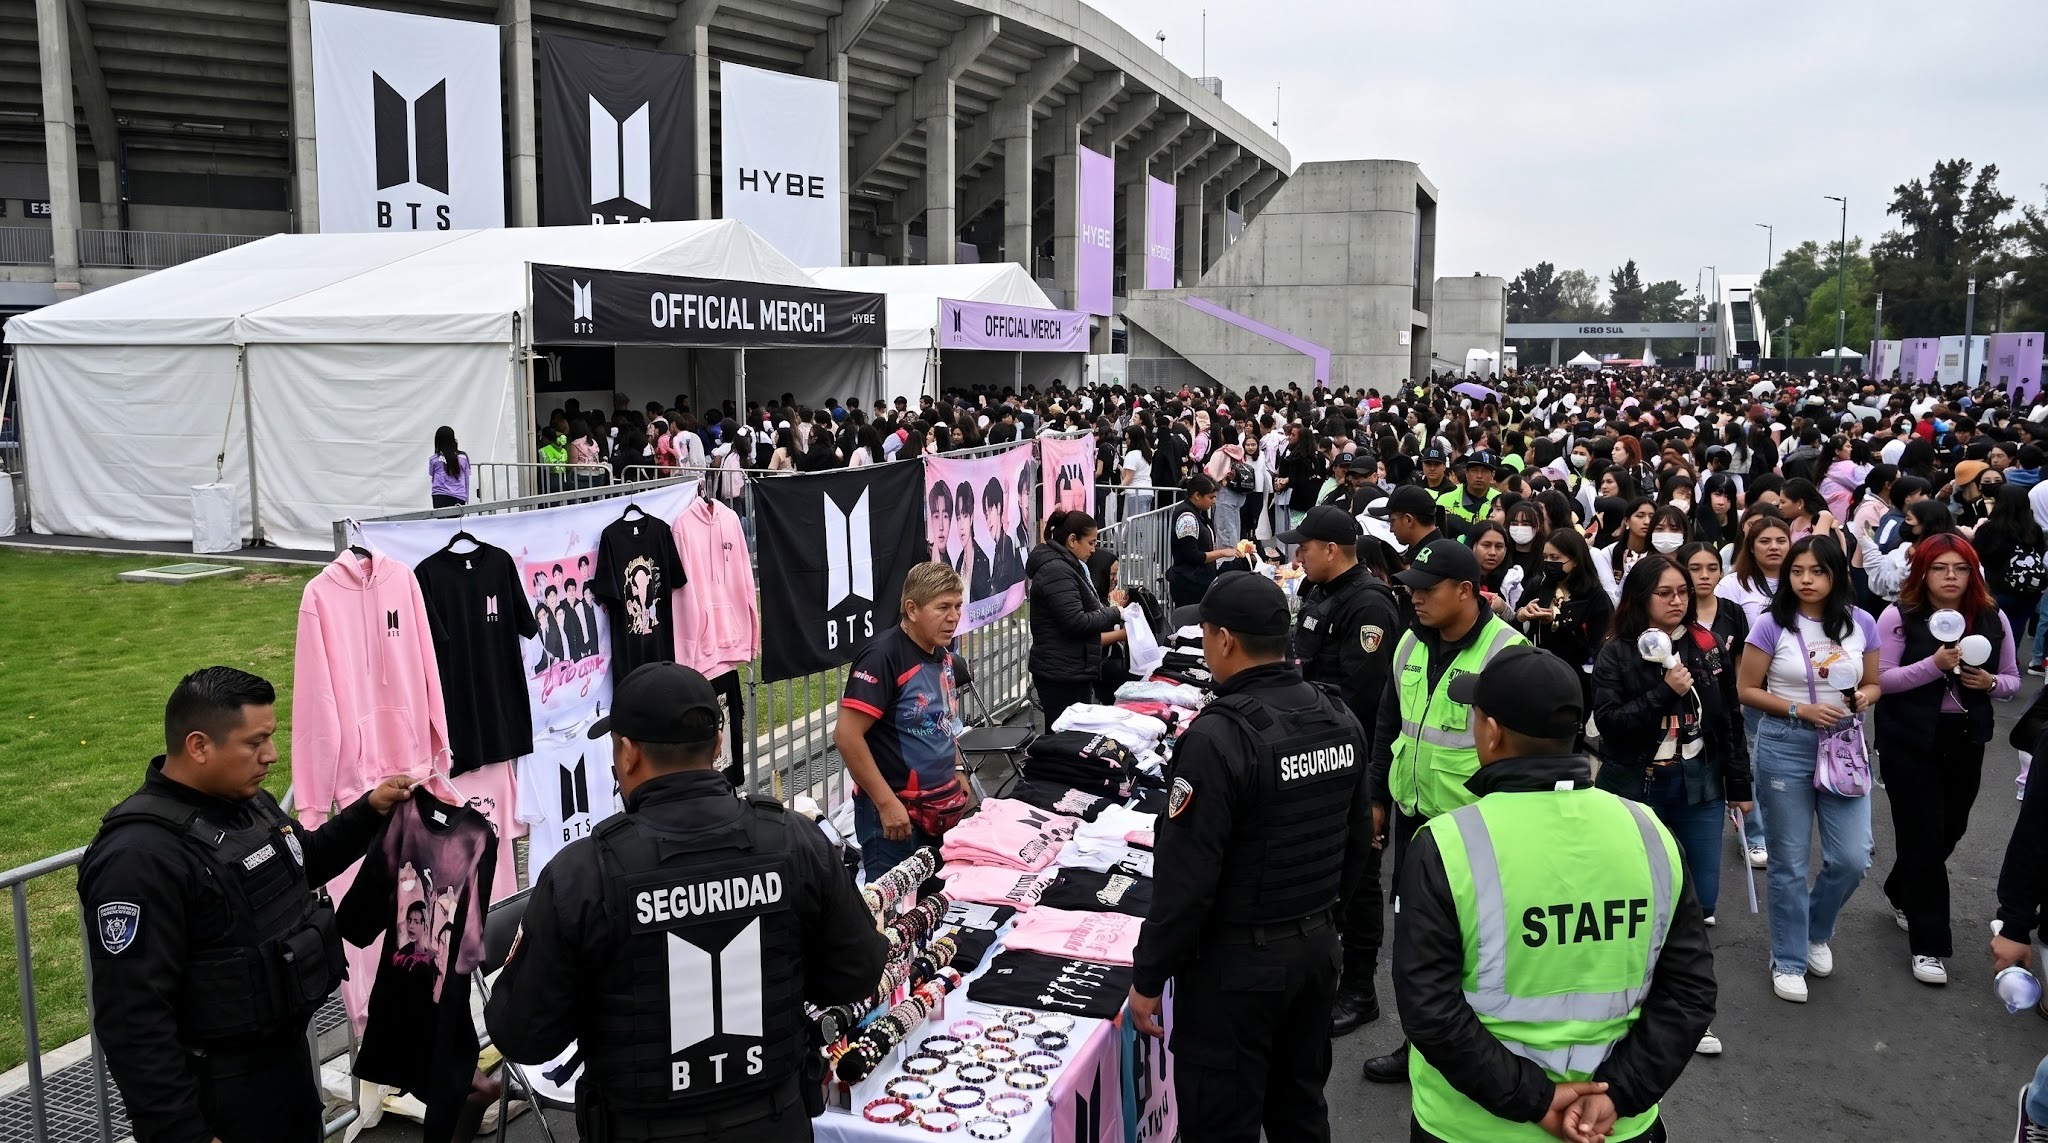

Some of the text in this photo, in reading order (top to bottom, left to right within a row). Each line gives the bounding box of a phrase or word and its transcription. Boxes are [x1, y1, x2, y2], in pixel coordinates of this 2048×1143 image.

[739, 167, 825, 199] HYBE
[377, 200, 450, 231] BTS
[1082, 223, 1111, 249] HYBE
[650, 291, 826, 333] OFFICIAL MERCH
[851, 312, 876, 325] HYBE
[985, 314, 1061, 340] OFFICIAL MERCH
[574, 322, 594, 334] BTS
[387, 630, 400, 638] BTS
[827, 609, 874, 651] BTS
[1280, 743, 1355, 782] SEGURIDAD
[563, 818, 592, 843] BTS
[636, 871, 783, 924] SEGURIDAD
[1521, 898, 1648, 948] STAFF
[671, 1045, 763, 1092] BTS
